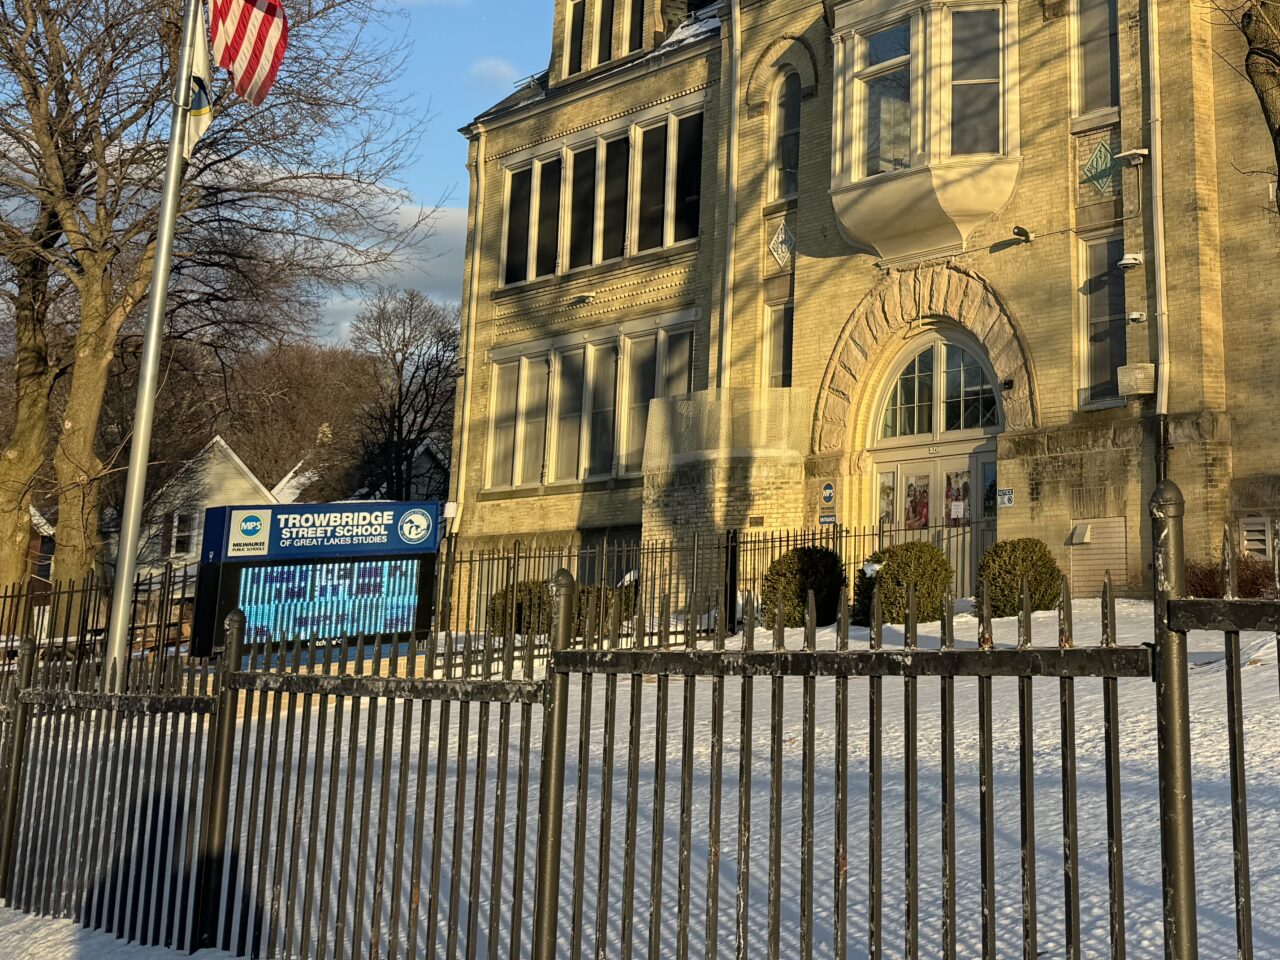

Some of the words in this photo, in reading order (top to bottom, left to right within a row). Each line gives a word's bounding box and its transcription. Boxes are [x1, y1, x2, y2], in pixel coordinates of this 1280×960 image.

[241, 521, 262, 530] MPS
[277, 511, 394, 528] TROWBRIDGE
[281, 526, 333, 538] STREET
[335, 525, 388, 537] SCHOOL
[280, 539, 292, 547] OF
[293, 538, 322, 547] GREAT
[323, 537, 351, 545] LAKES
[352, 535, 387, 544] STUDIES
